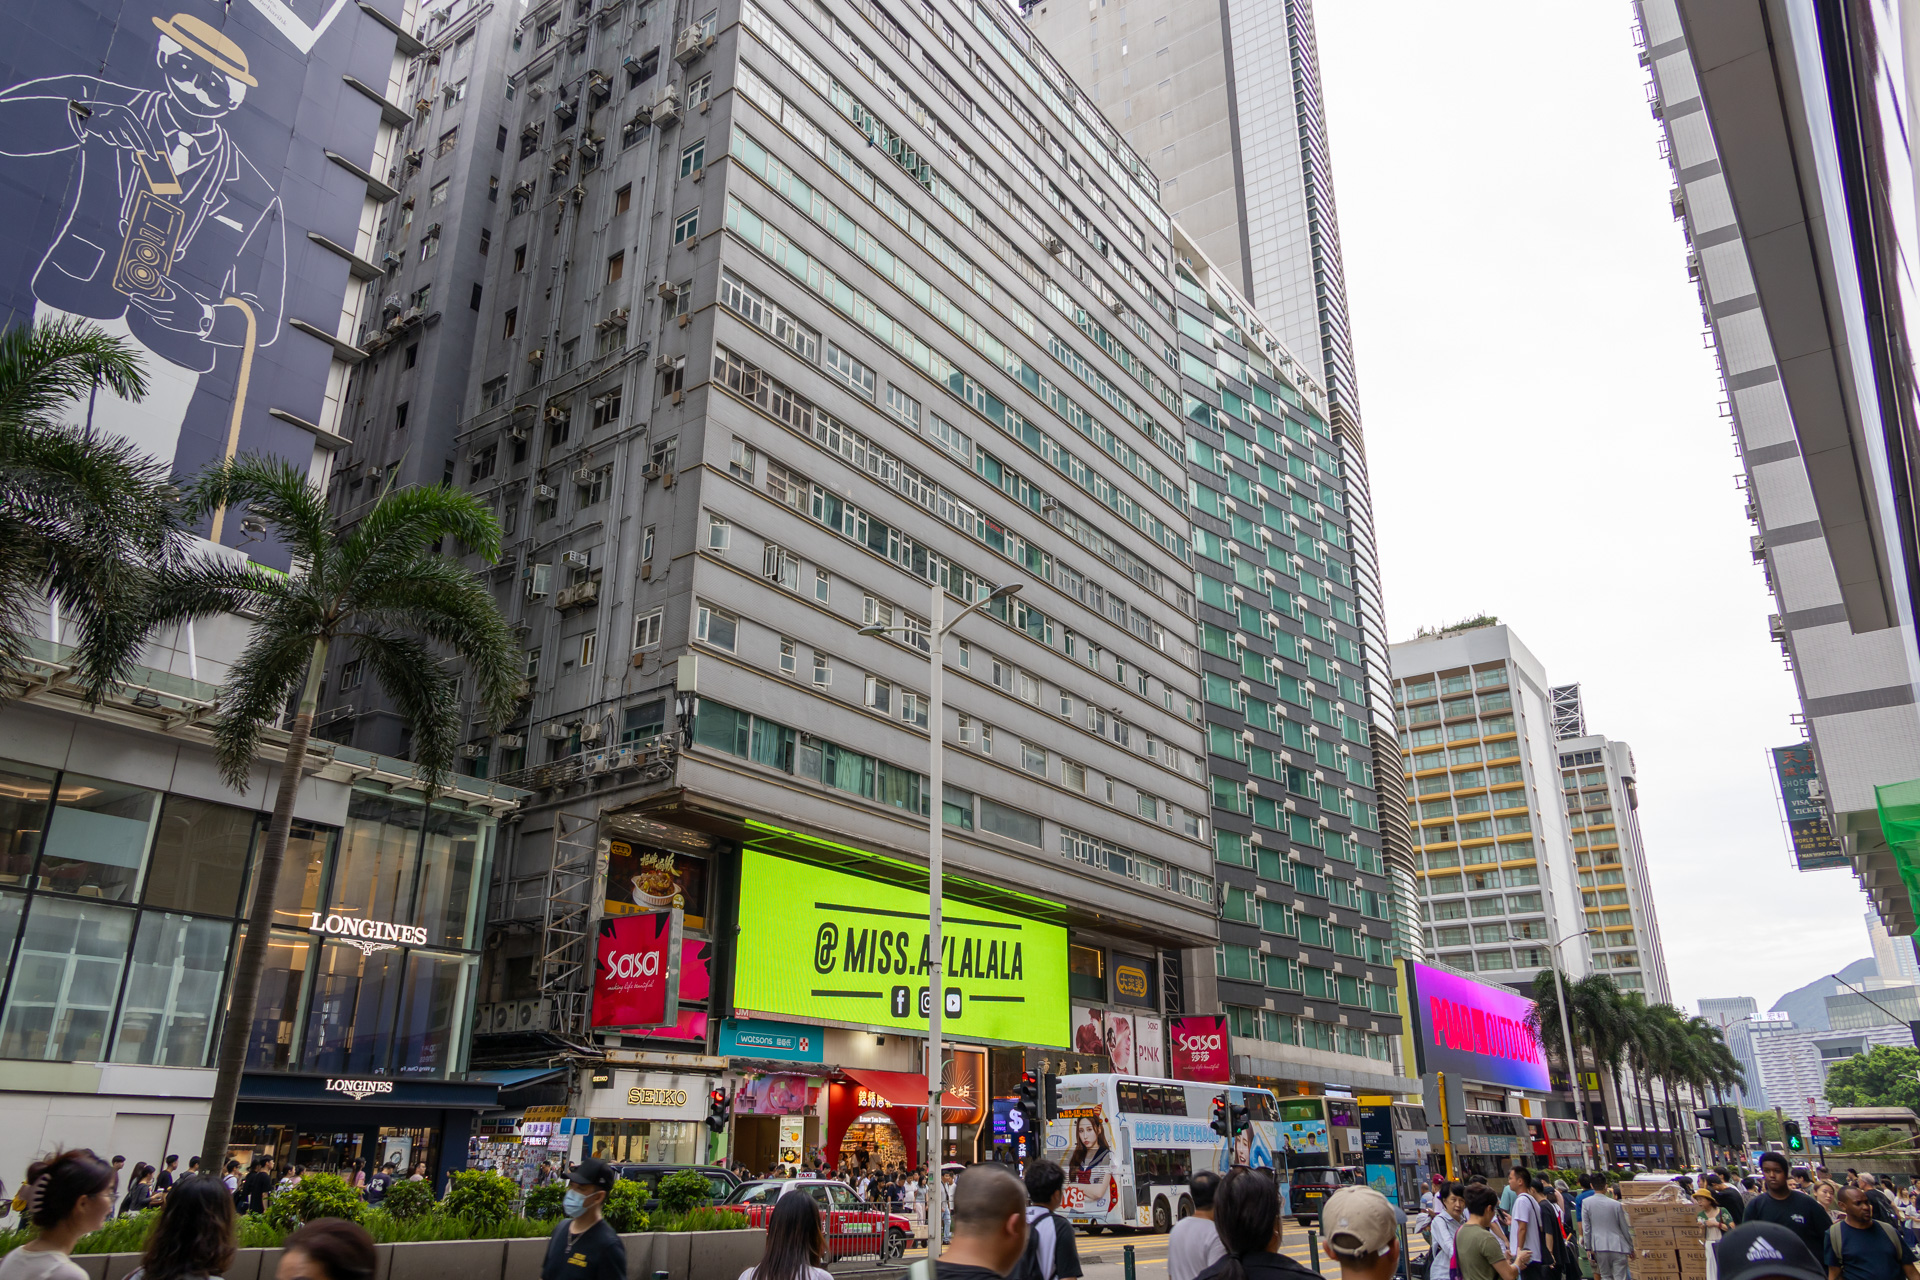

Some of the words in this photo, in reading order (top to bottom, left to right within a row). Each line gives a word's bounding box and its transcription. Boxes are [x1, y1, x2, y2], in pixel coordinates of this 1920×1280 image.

[309, 912, 427, 945] LONGINES
[1430, 996, 1475, 1053] POAD
[741, 1035, 773, 1045] watsons
[1191, 1051, 1210, 1062] 莎莎
[325, 1079, 393, 1093] LONGINES
[628, 1087, 688, 1106] SEIKO
[1135, 1121, 1171, 1141] HAPPY
[1746, 1250, 1783, 1261] adidas
